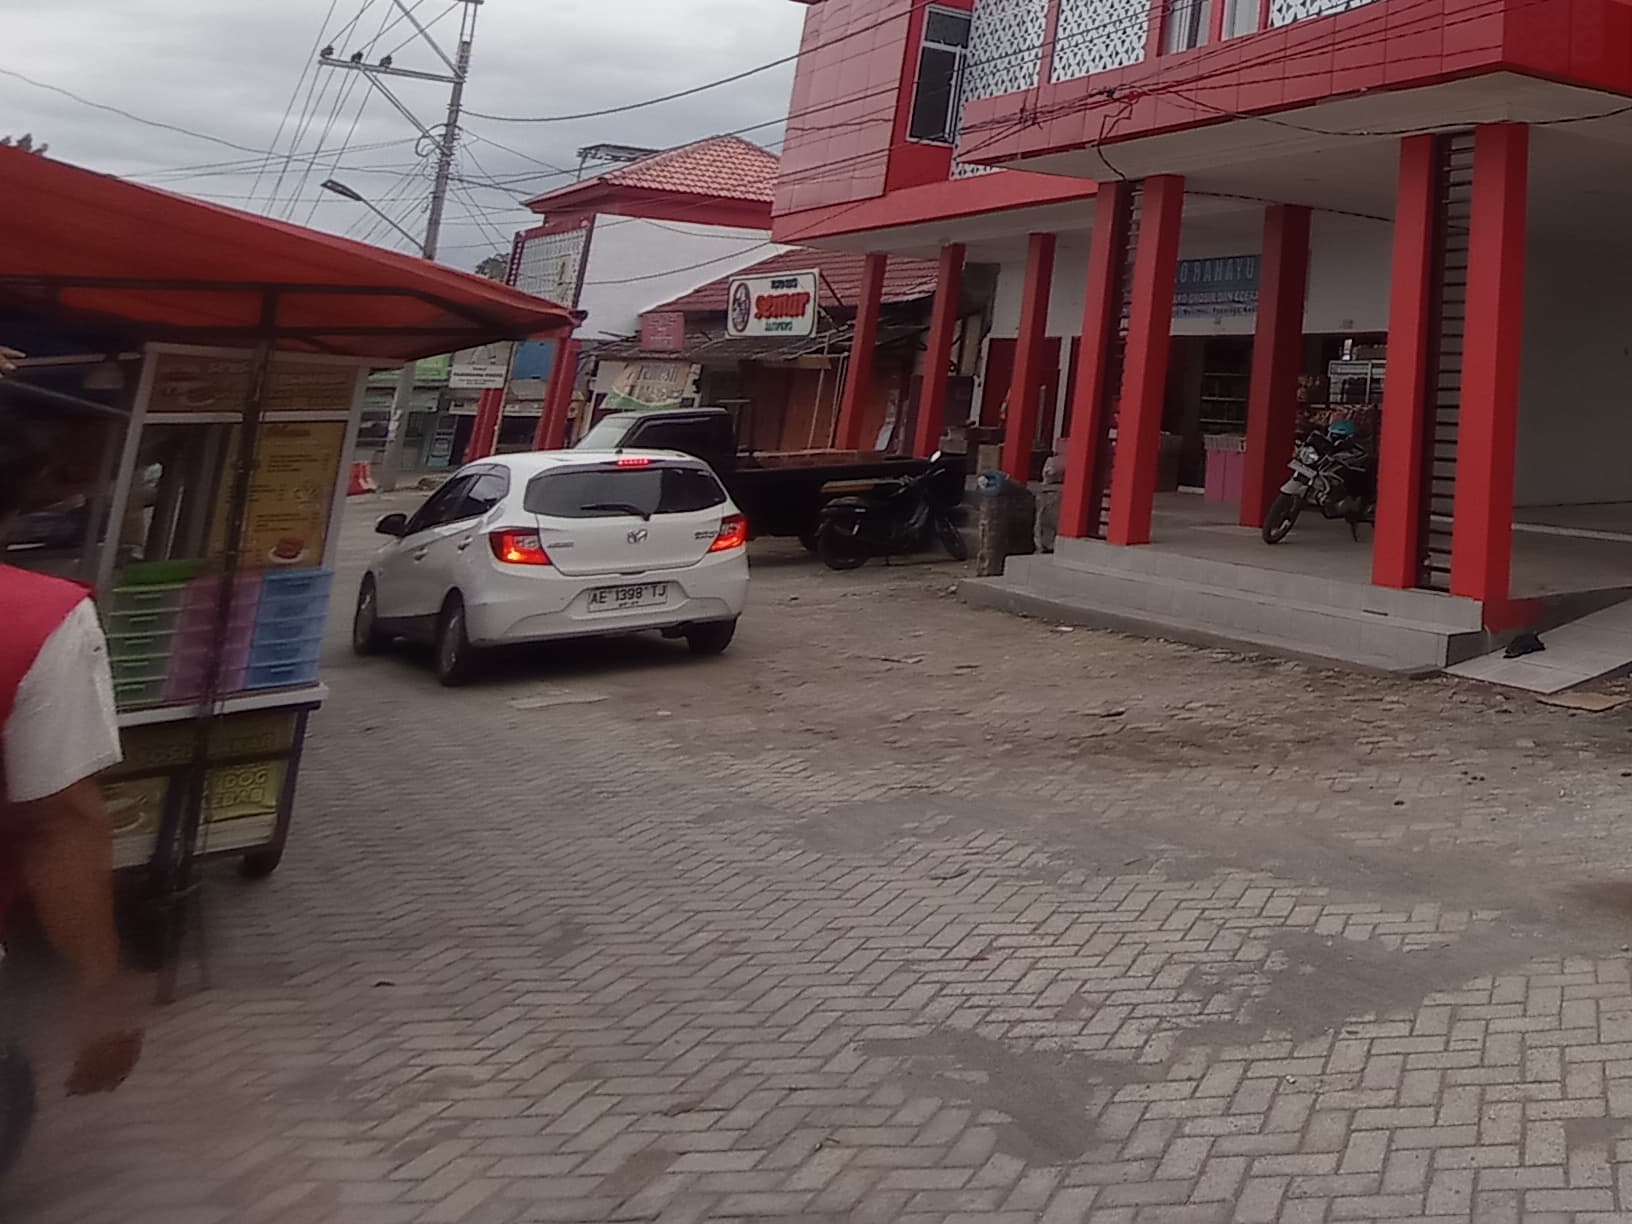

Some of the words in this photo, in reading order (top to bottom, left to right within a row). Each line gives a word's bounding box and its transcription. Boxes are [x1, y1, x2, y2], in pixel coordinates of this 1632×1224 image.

[1192, 257, 1255, 283] RAHAYU
[590, 590, 607, 604] AE
[615, 586, 643, 601] 1398
[651, 584, 667, 598] TJ
